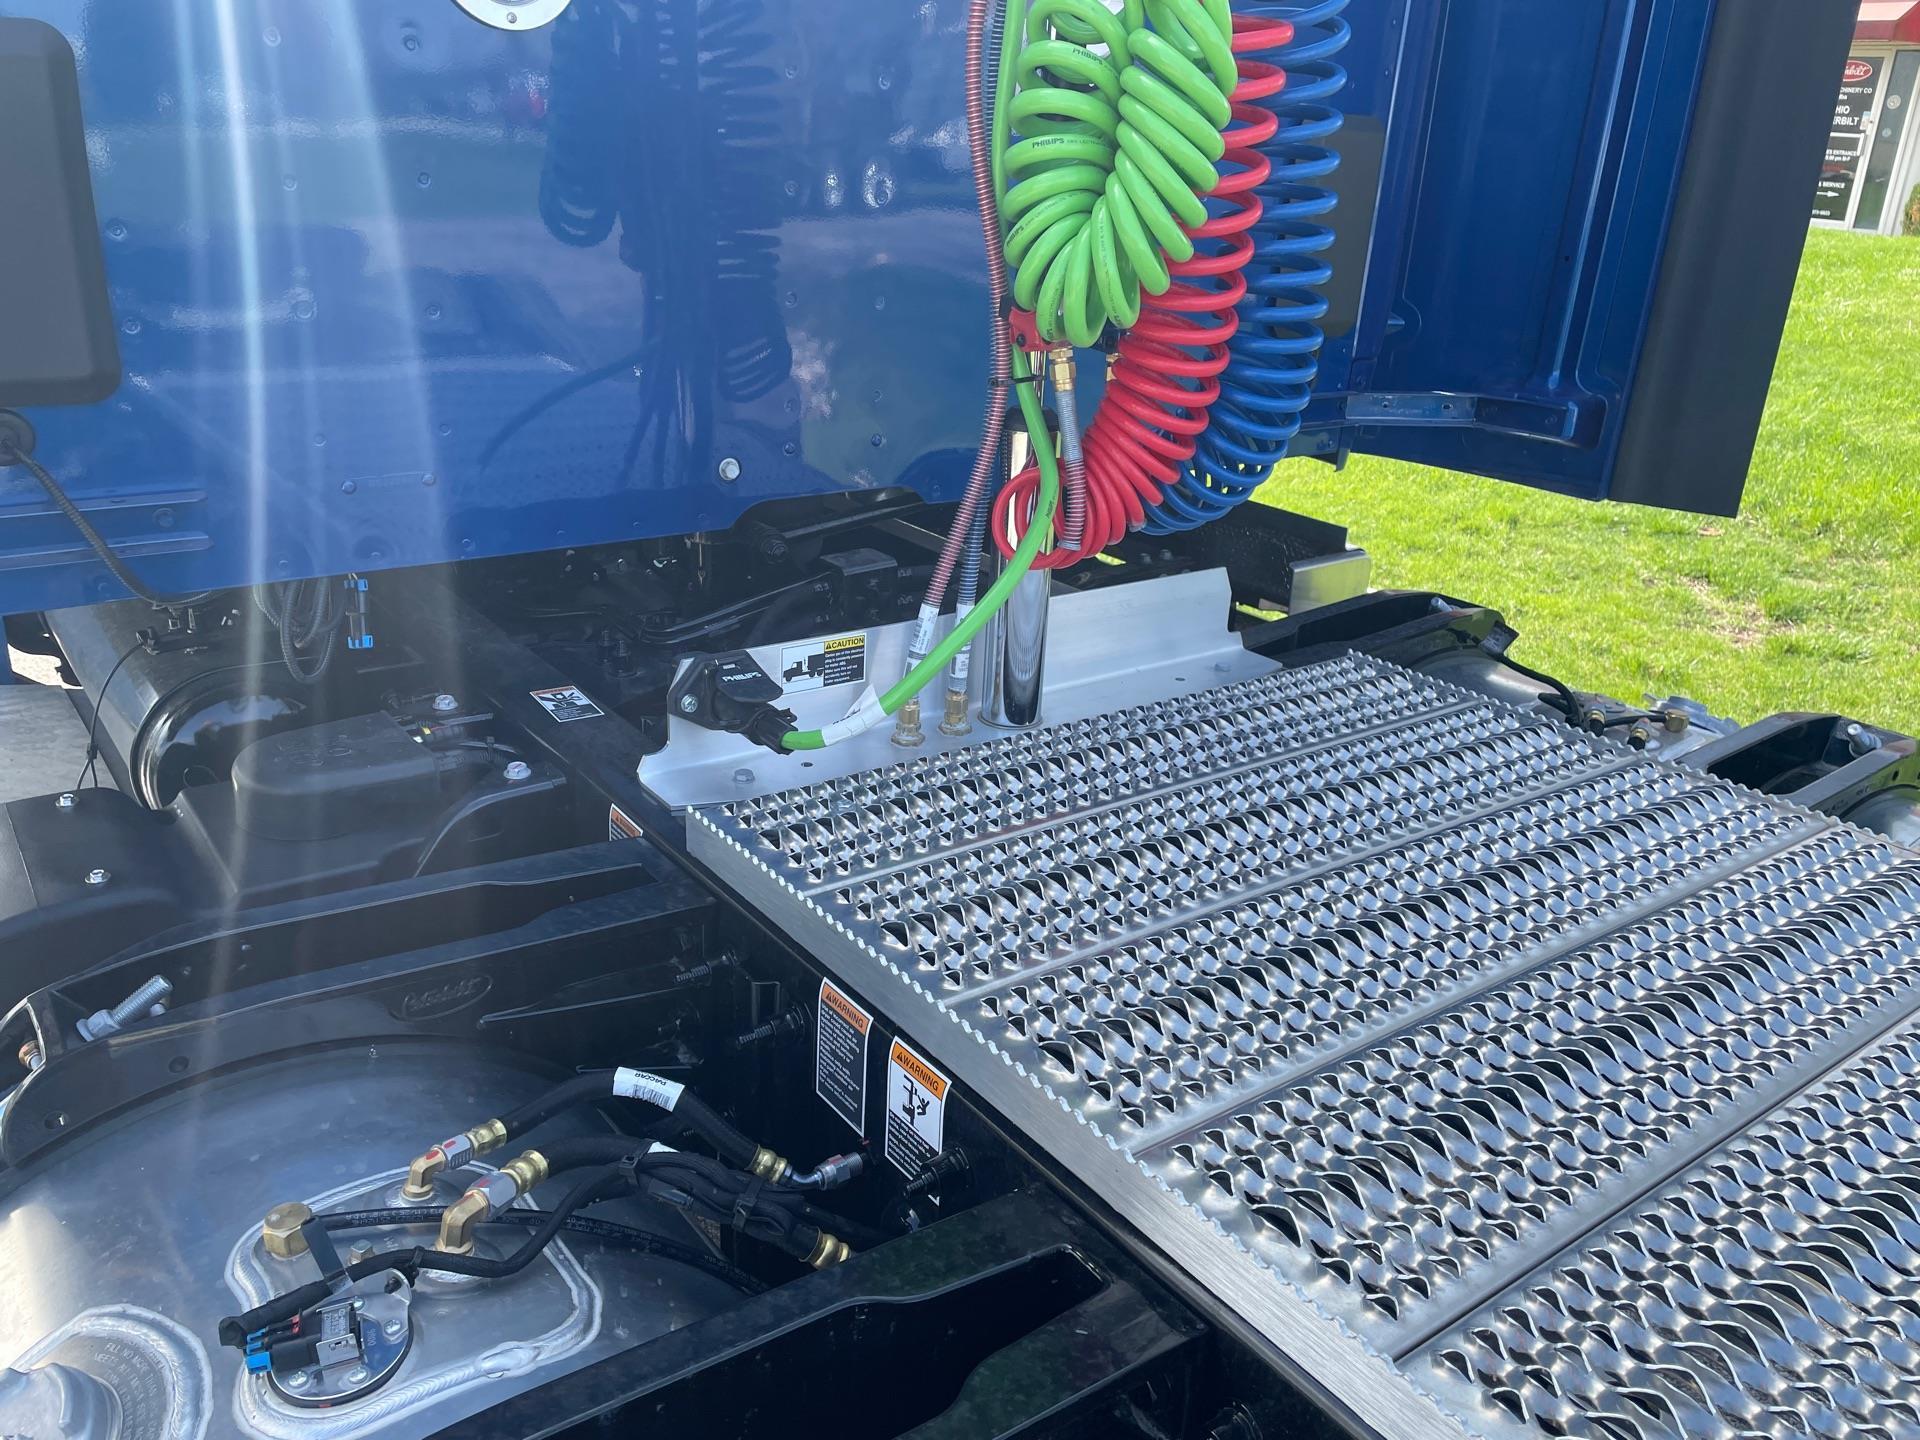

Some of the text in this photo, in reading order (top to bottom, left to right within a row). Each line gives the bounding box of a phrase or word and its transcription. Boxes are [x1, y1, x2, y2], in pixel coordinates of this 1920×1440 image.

[1835, 105, 1850, 114] HIO
[832, 638, 864, 649] CAUTION
[832, 994, 864, 1028] WARNING
[903, 1054, 938, 1092] WARNING
